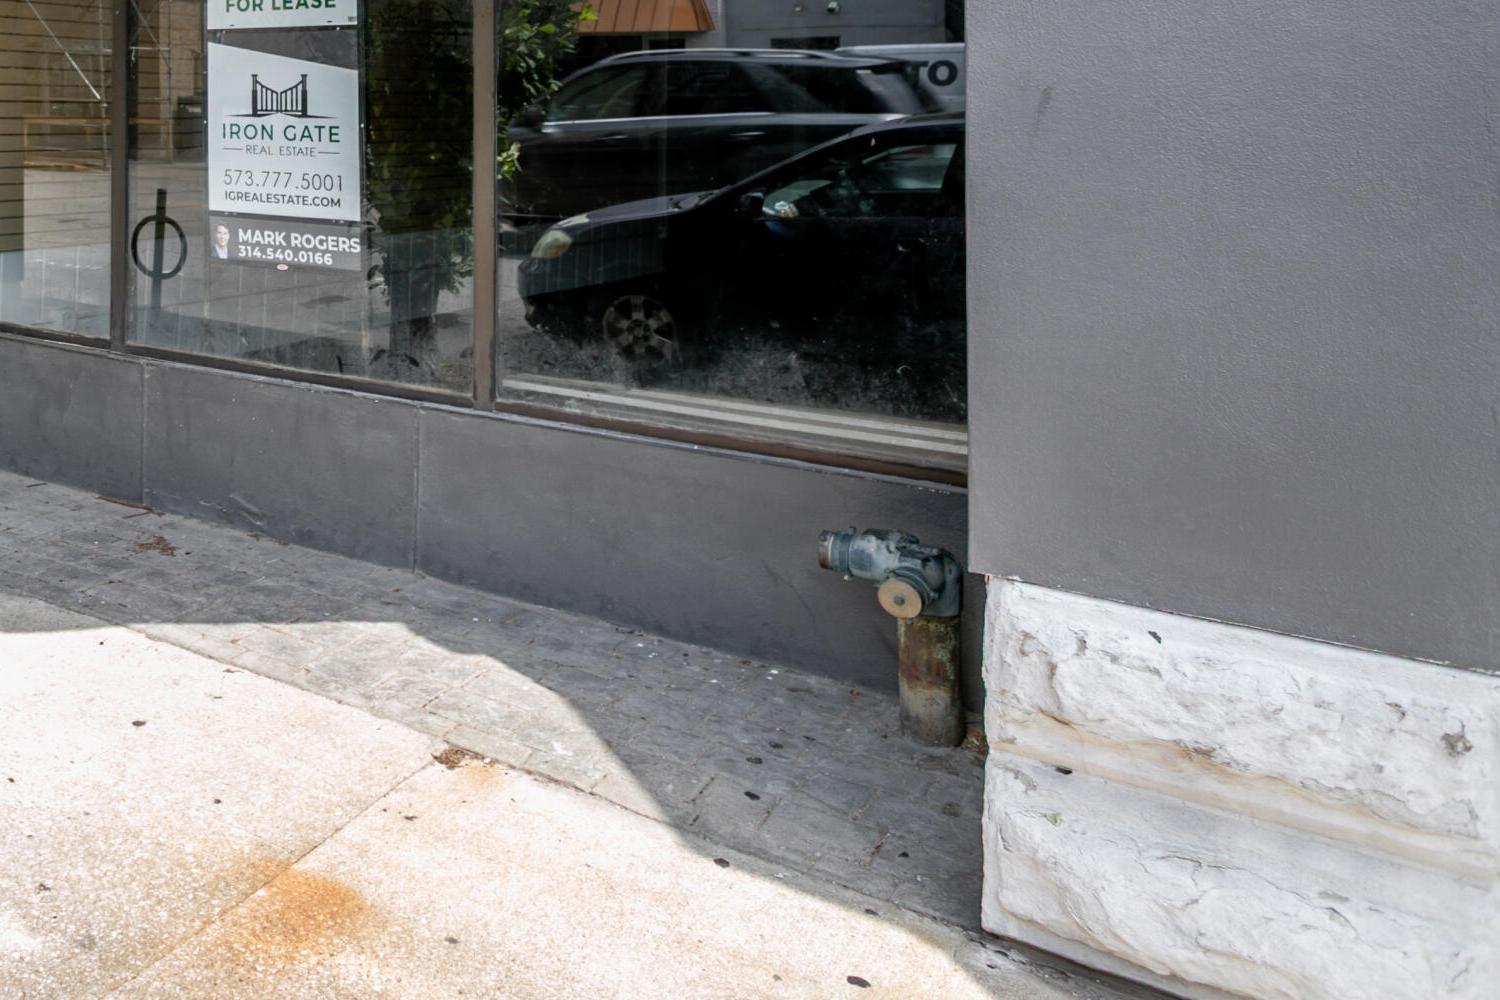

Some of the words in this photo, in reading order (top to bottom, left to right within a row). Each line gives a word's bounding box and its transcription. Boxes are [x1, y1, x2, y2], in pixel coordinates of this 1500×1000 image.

[222, 123, 274, 141] IRON
[283, 124, 341, 143] GATE
[245, 144, 273, 156] REAL
[279, 146, 316, 158] ESTATE
[223, 168, 343, 192] 573.777.5001
[224, 190, 342, 208] IGREALESTATE.COM
[238, 228, 287, 247] MARK
[290, 232, 361, 253] ROGERS
[238, 246, 333, 265] 314.540.0166
